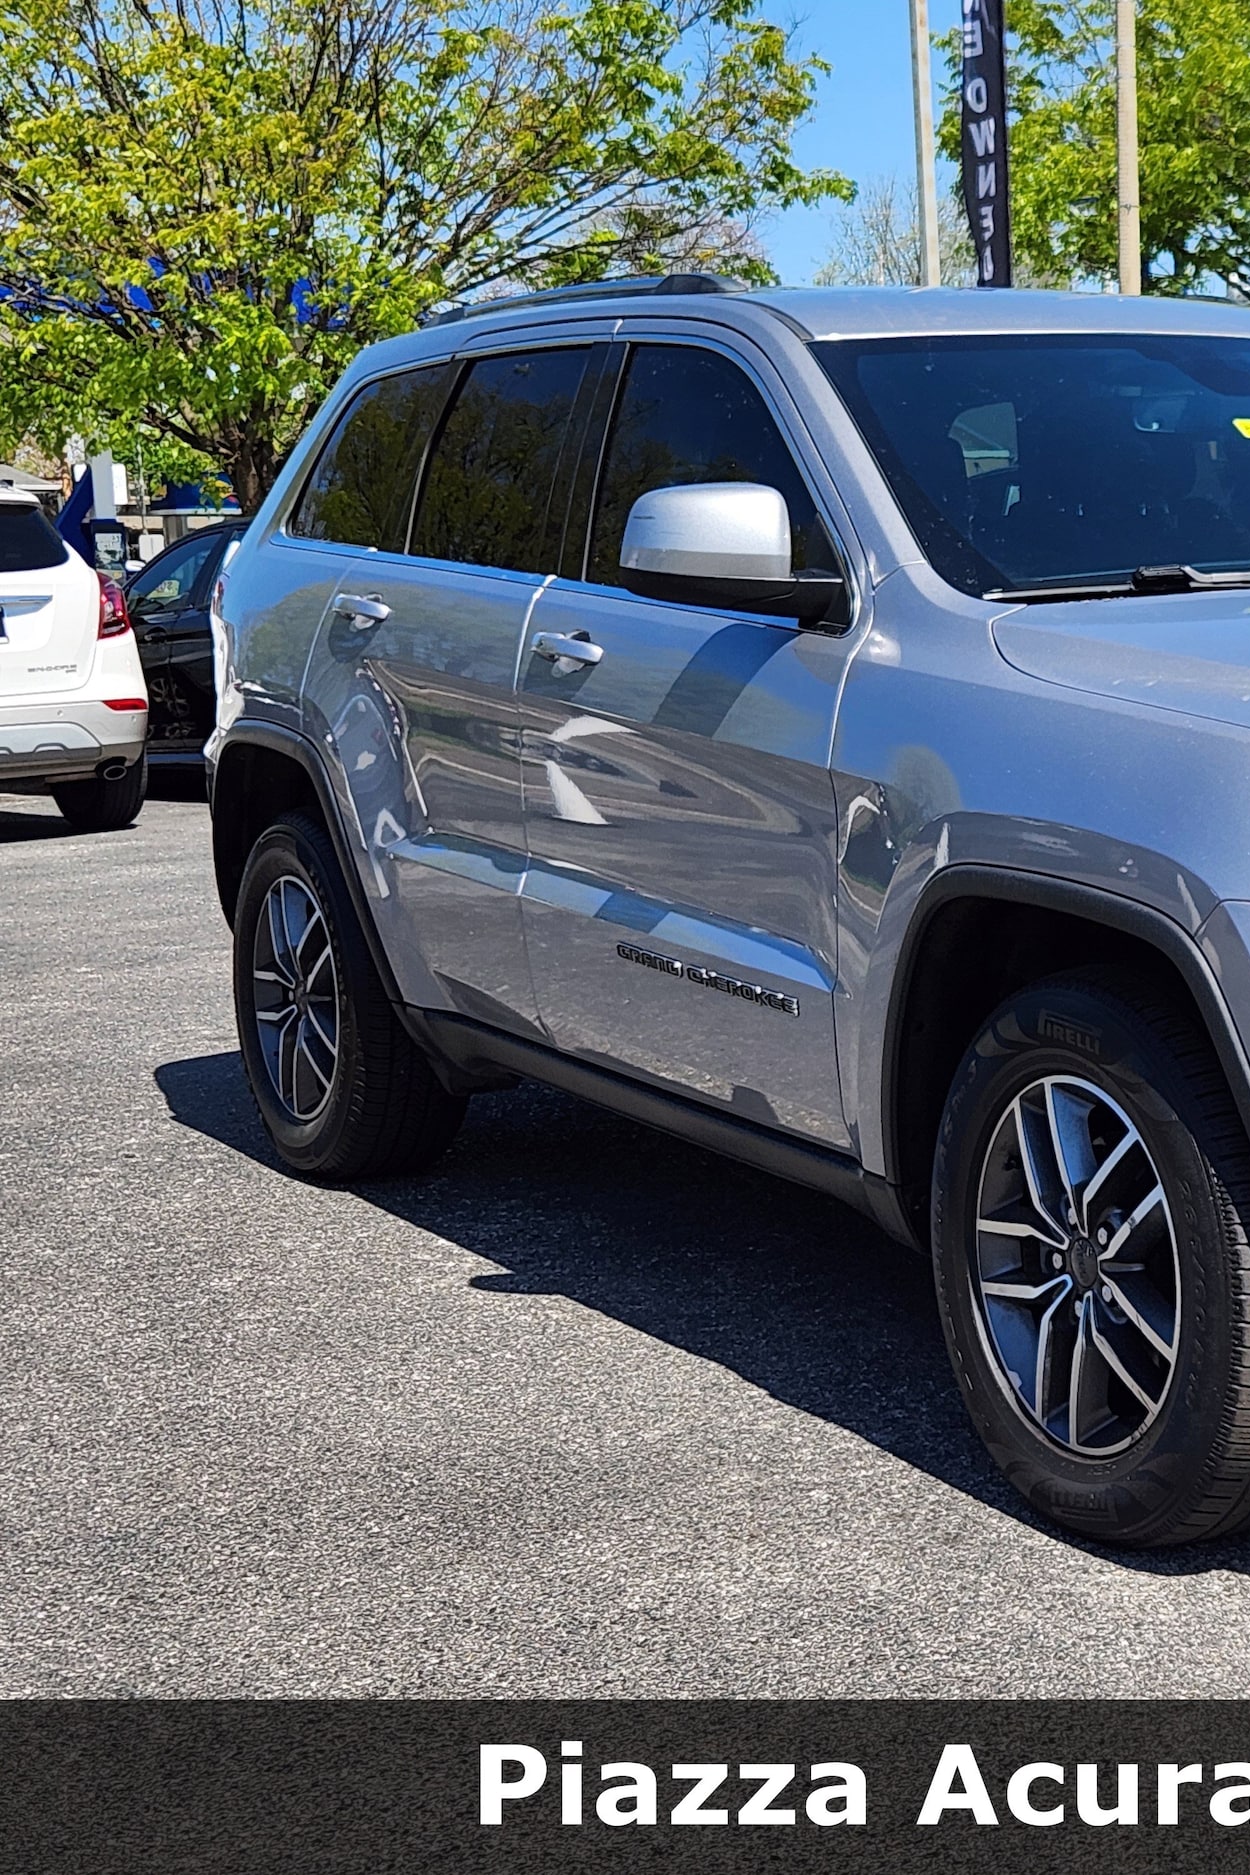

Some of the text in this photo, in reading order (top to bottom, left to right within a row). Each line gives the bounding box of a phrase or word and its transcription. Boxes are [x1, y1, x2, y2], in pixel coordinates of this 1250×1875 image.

[617, 941, 800, 1018] GRAND CHEROKEE
[1037, 1008, 1103, 1055] PIRELLI
